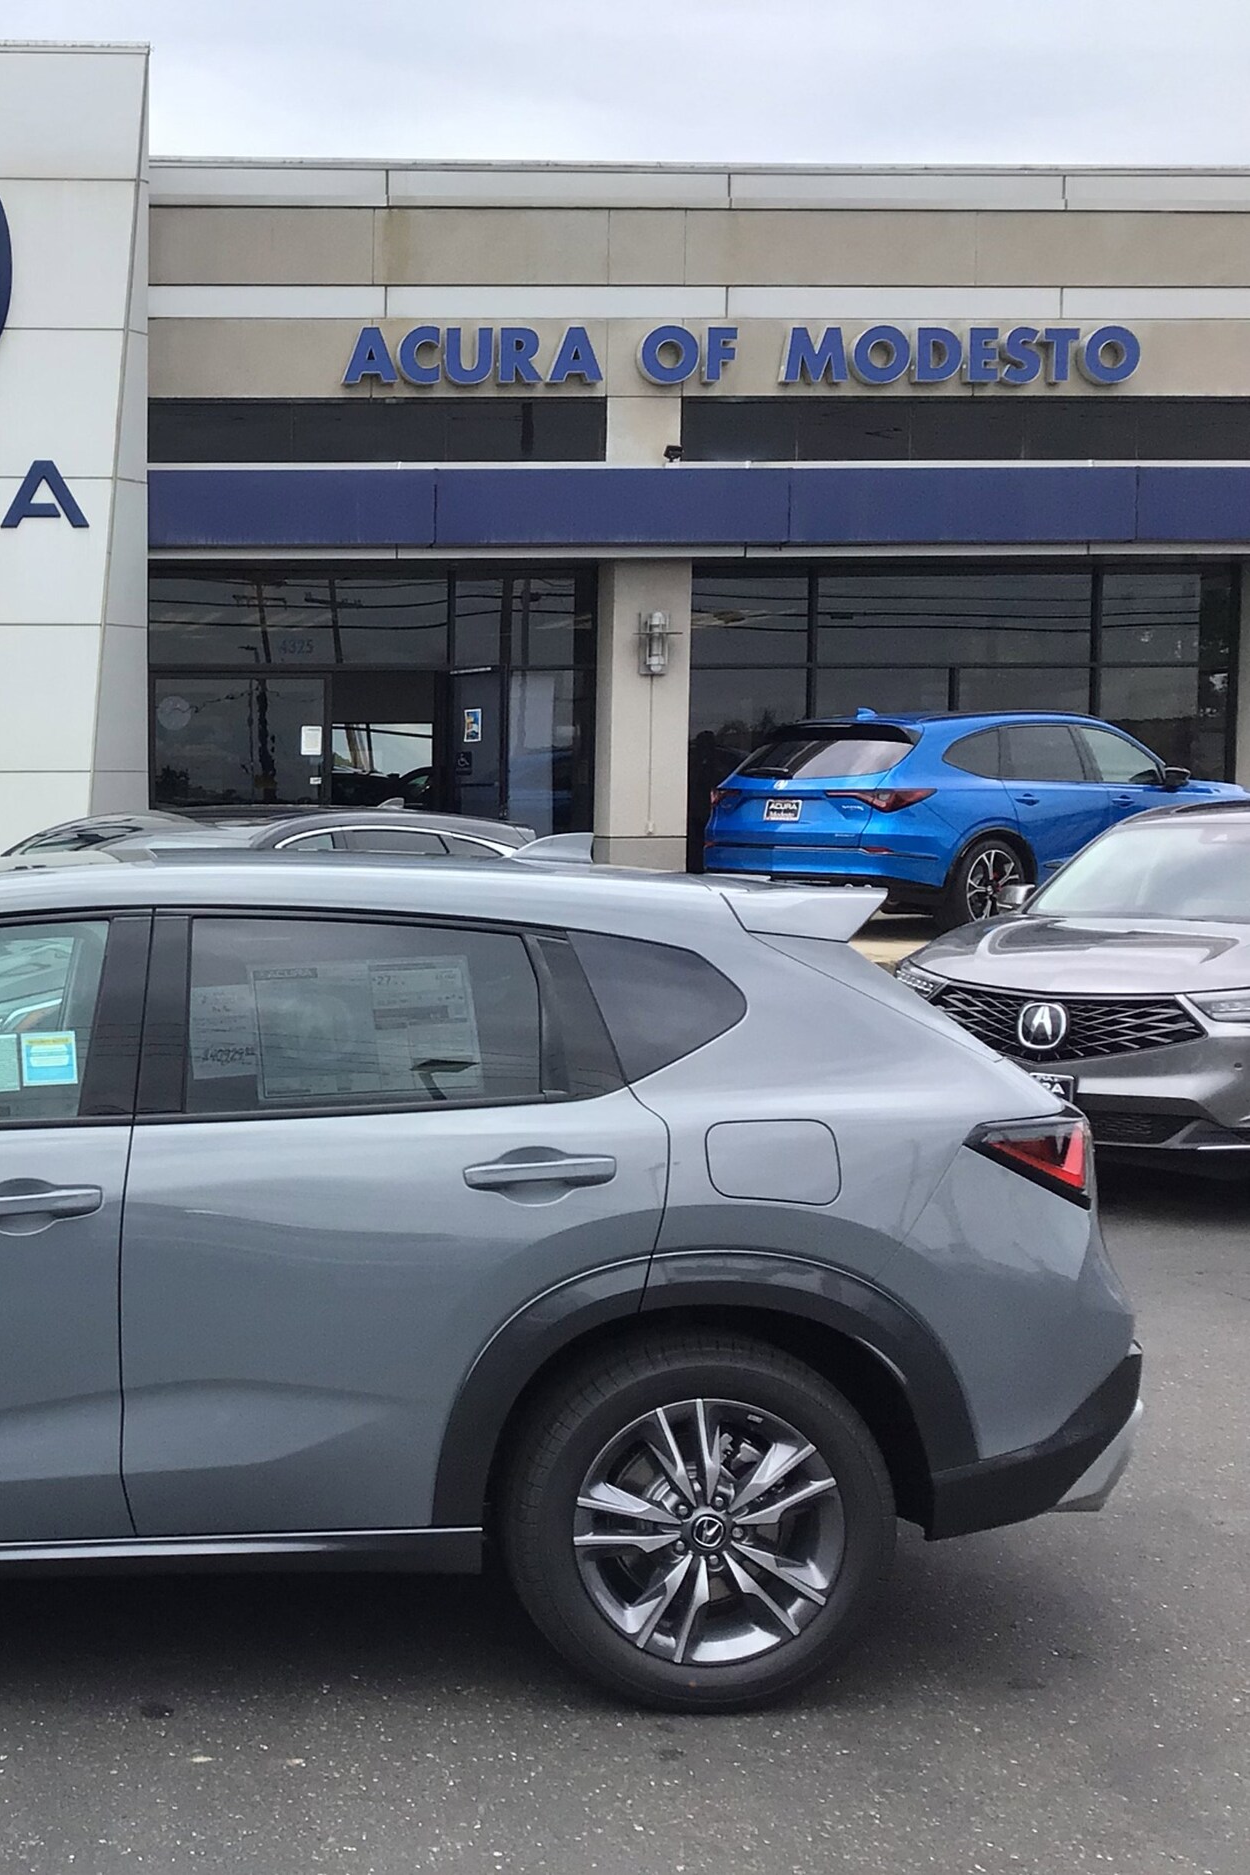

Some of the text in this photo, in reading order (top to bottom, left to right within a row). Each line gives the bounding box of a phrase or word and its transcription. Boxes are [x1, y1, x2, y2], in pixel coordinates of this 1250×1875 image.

[342, 324, 1141, 385] ACURA OF MODESTO
[279, 639, 314, 654] 4325
[769, 802, 797, 810] ACURA
